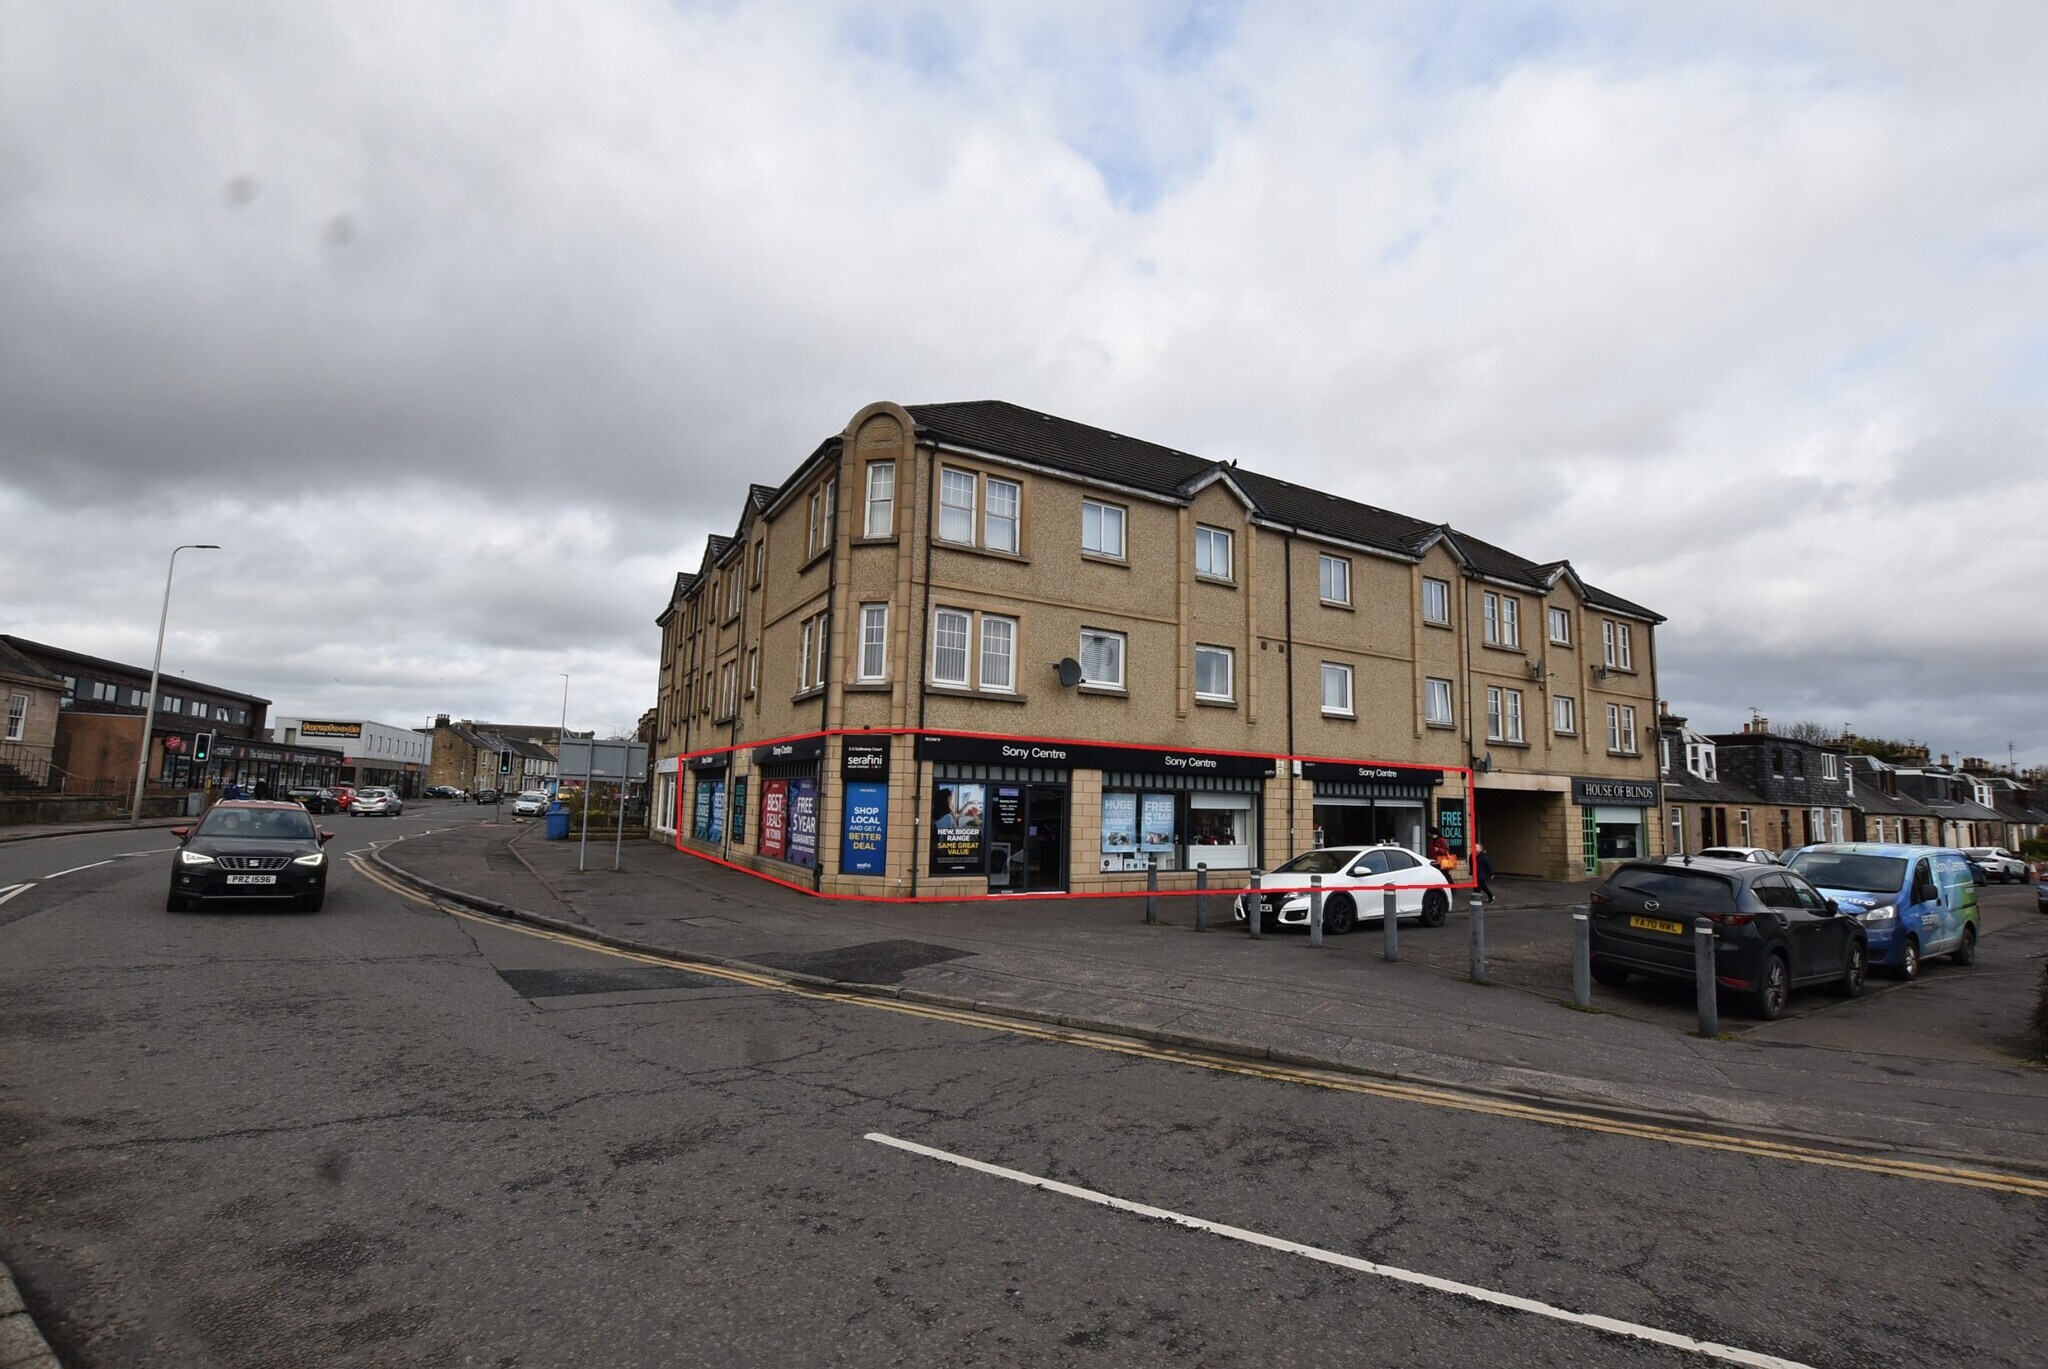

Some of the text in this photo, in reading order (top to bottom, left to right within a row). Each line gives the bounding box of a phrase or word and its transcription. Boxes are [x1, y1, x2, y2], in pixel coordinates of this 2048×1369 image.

[303, 723, 360, 733] farmfoods
[1002, 746, 1066, 760] Sony Centre
[848, 754, 882, 765] serafini
[1165, 756, 1217, 768] Sony Centre
[1359, 768, 1398, 778] Sony Centre
[1585, 784, 1653, 798] HOUSE OF BLINDS
[767, 793, 783, 811] BEST
[797, 797, 813, 813] FREE
[1105, 800, 1133, 810] HUGE
[1144, 801, 1172, 812] FREE
[854, 806, 879, 815] SHOP
[1105, 810, 1133, 818] WINTER
[766, 813, 782, 828] DEALS
[793, 814, 816, 833] 5 YEAR
[851, 816, 880, 824] LOCAL
[1144, 812, 1172, 825] 5 YEAR
[1441, 811, 1462, 826] FREE
[849, 832, 881, 841] BETTER
[1441, 827, 1462, 838] LOCAL
[792, 834, 815, 846] GUARANTEE
[853, 842, 876, 850] DEAL
[1632, 917, 1657, 928] YA70
